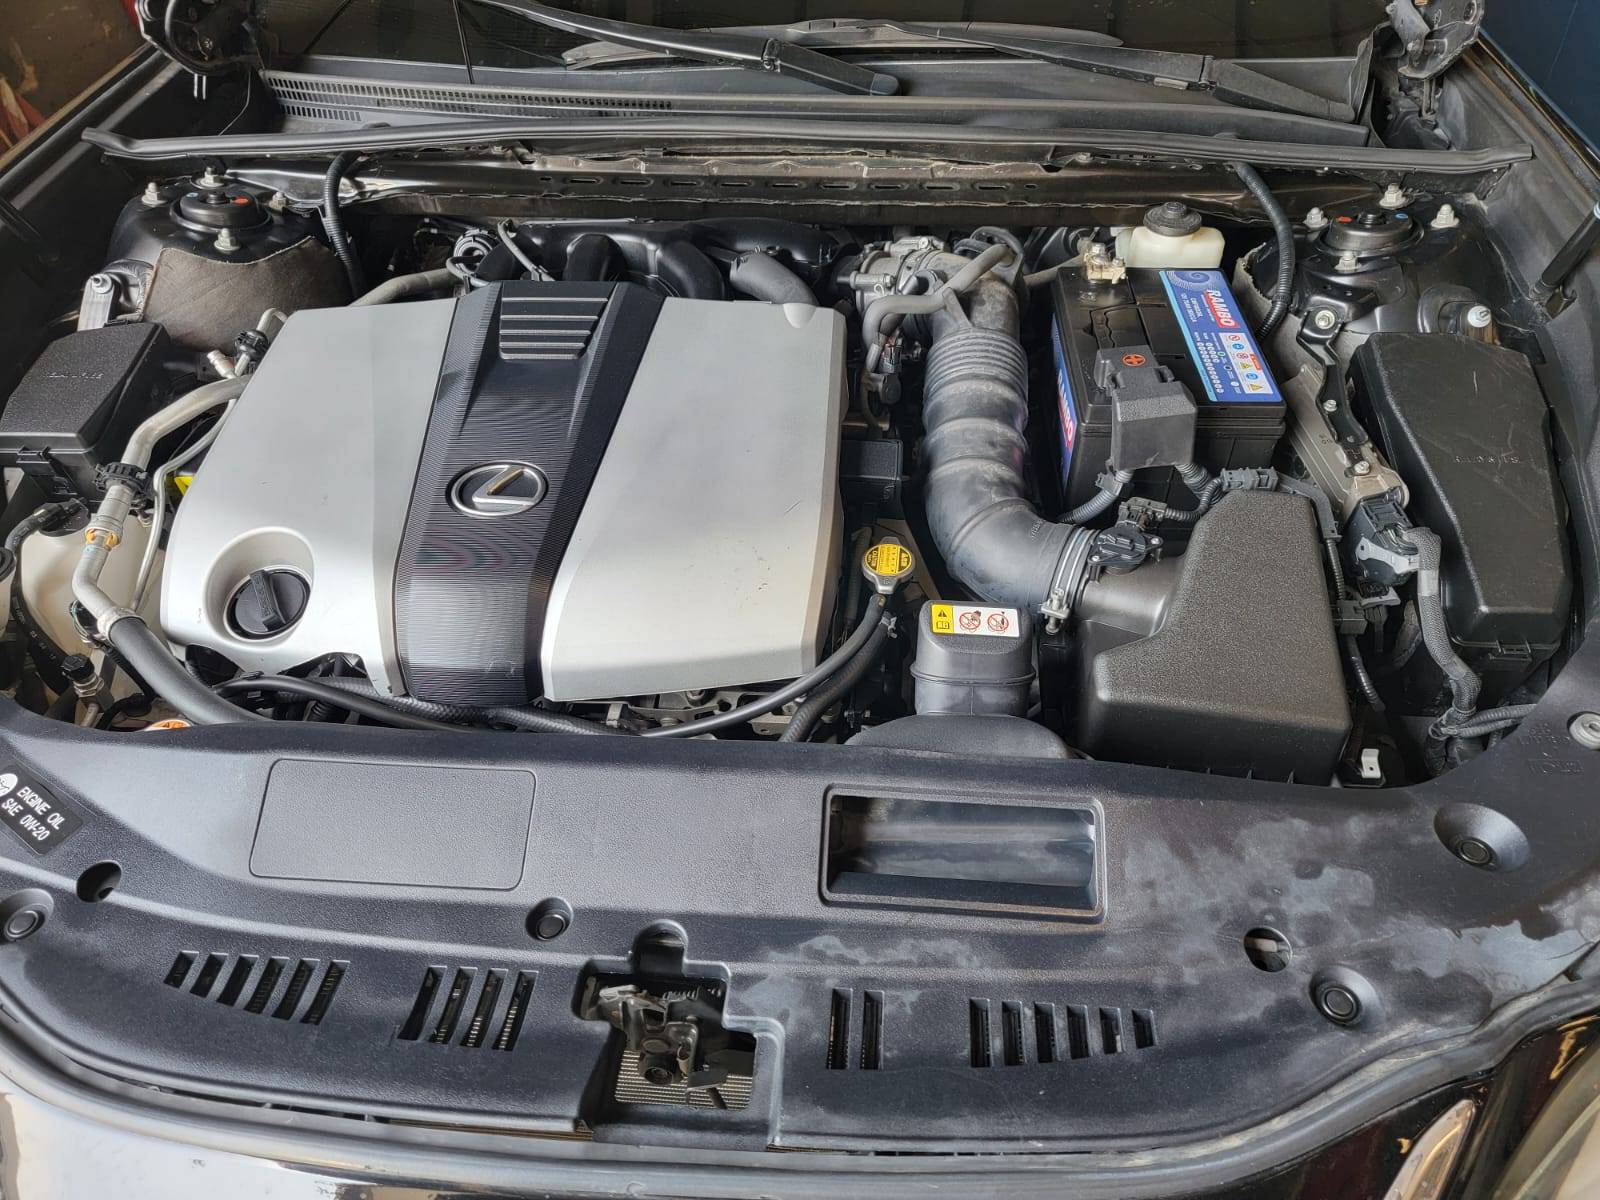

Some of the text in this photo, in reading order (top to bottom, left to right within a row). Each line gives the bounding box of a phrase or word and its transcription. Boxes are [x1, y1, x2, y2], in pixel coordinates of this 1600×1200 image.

[1207, 289, 1236, 327] RAMBO
[1057, 368, 1073, 442] RAMBO
[1, 798, 24, 816] SAE
[17, 786, 66, 830] ENGINE OIL
